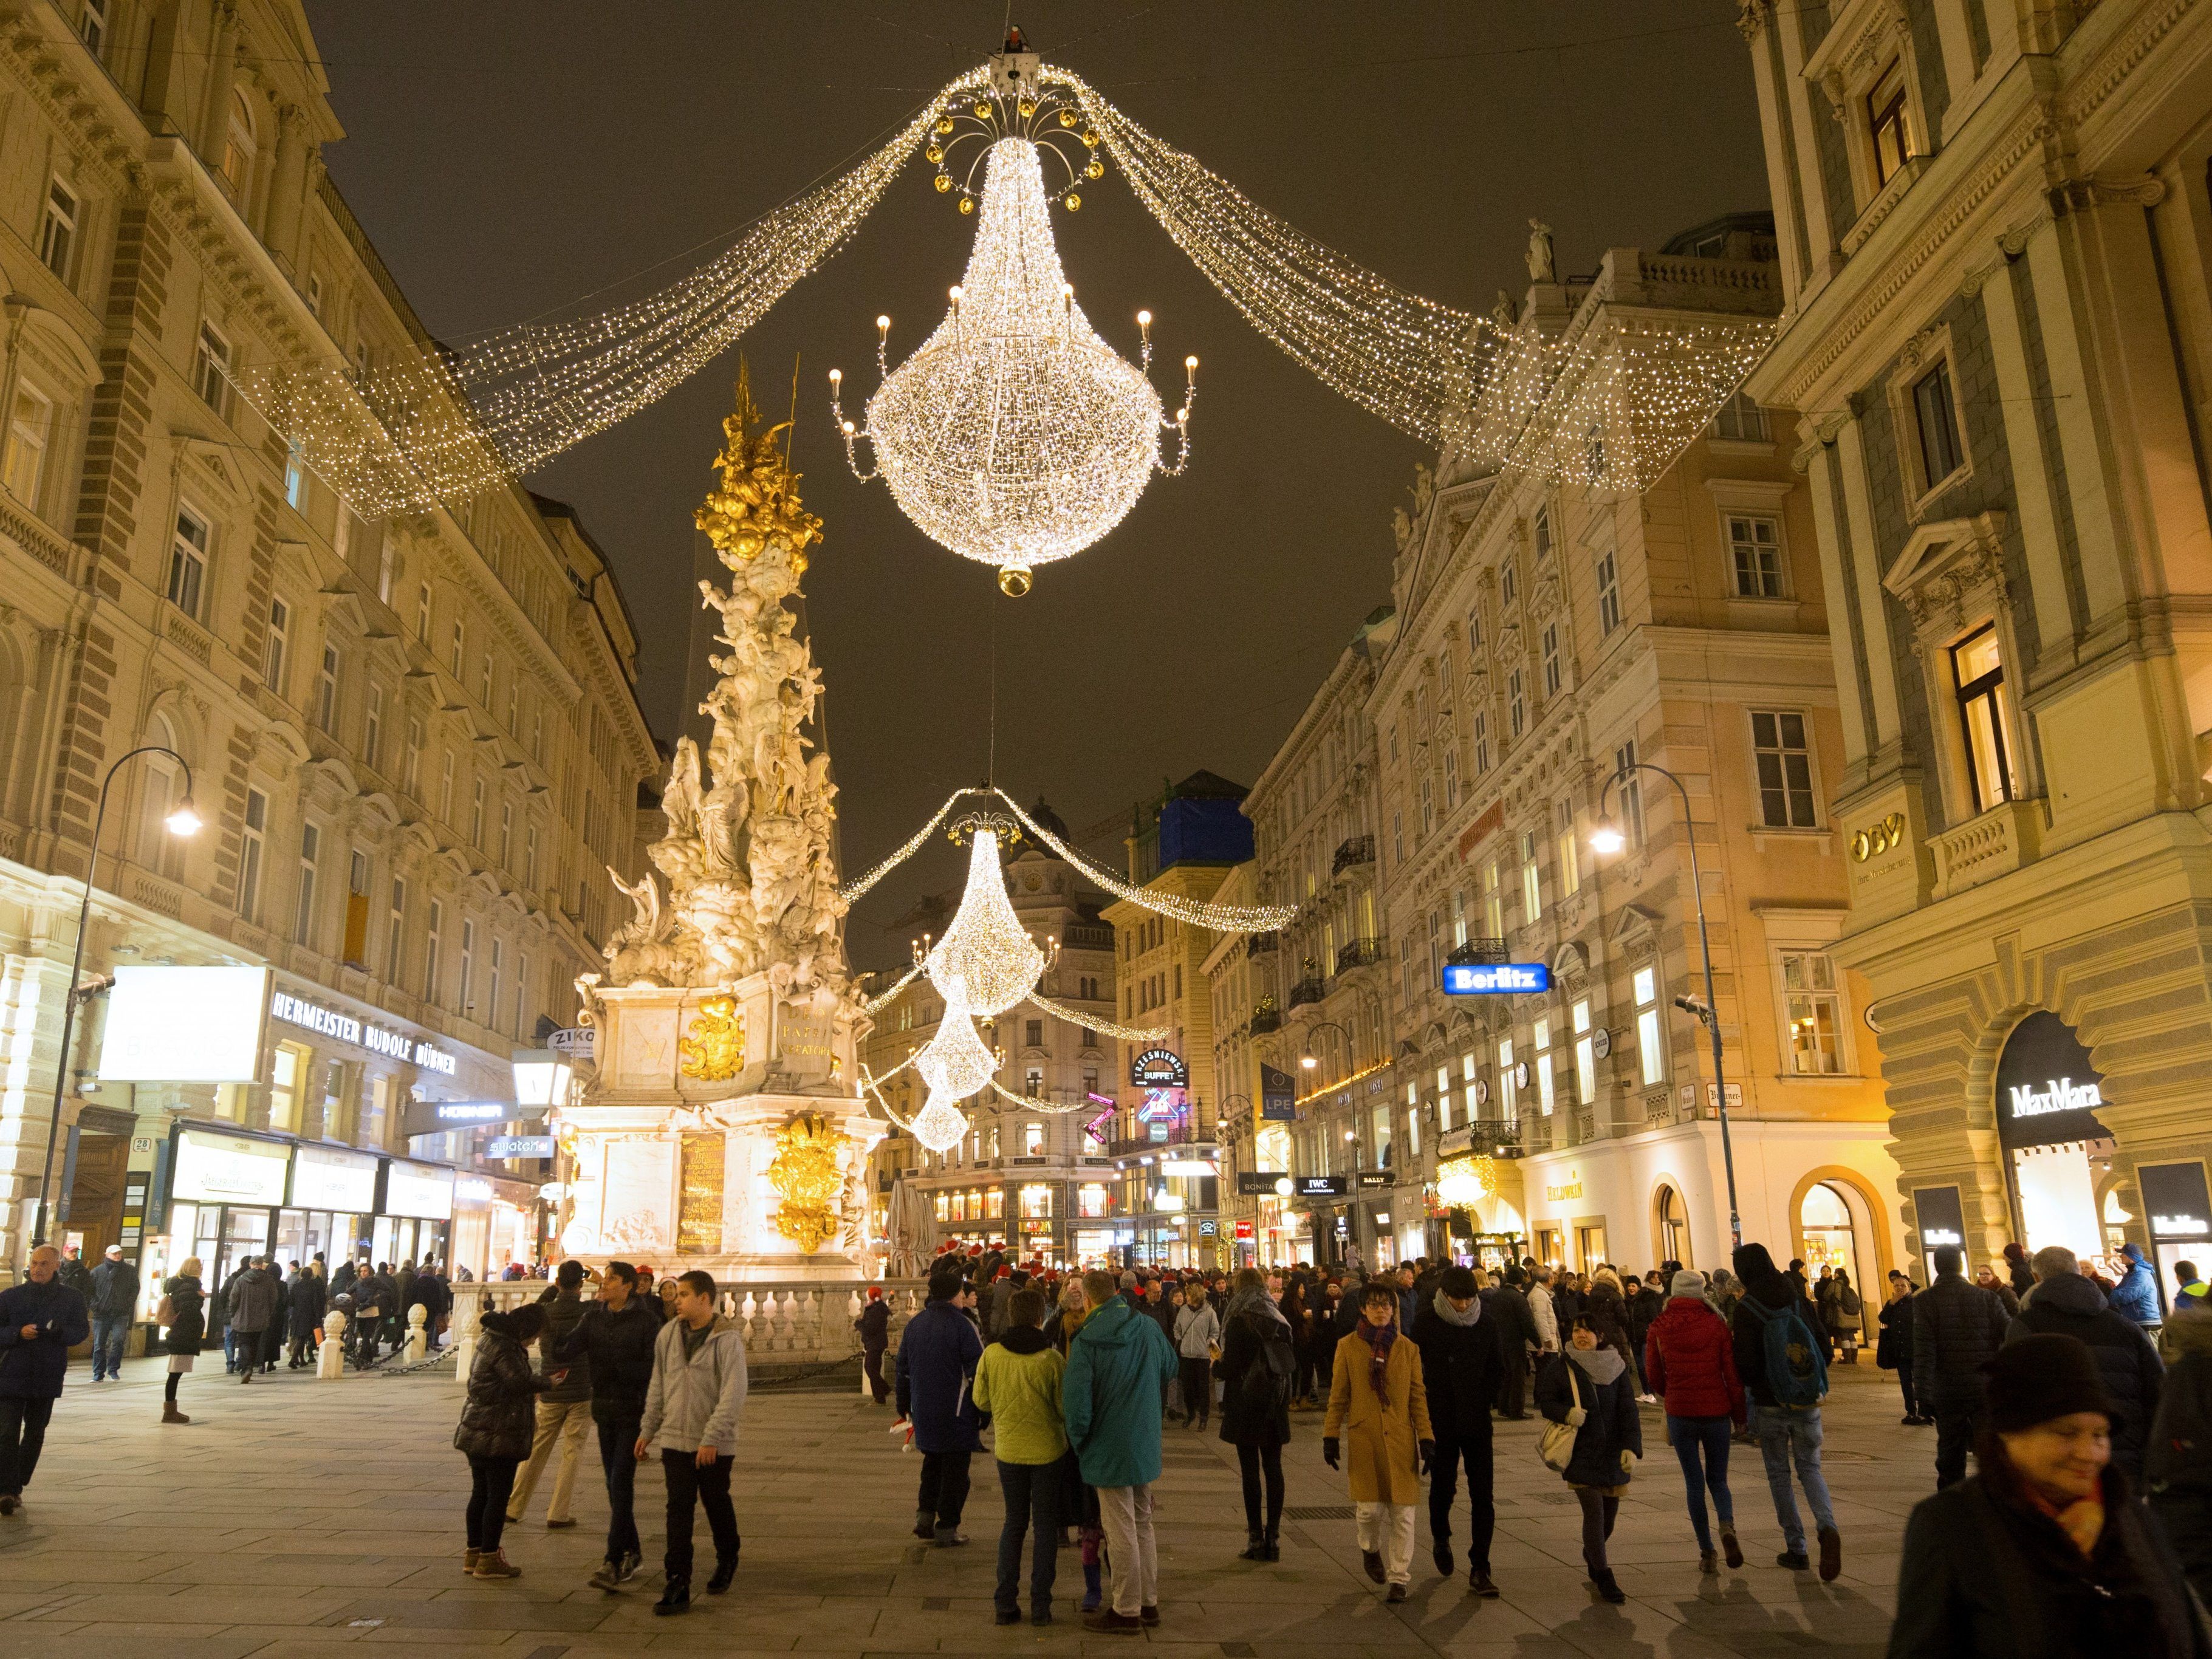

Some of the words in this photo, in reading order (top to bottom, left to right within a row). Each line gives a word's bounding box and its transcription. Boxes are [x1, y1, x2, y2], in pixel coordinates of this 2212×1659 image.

[1455, 967, 1536, 988] Berlitz
[788, 1005, 825, 1019] DEO
[365, 1025, 412, 1059] RUDOLF
[416, 1042, 456, 1075] HÜBNER
[1134, 1050, 1185, 1078] TRZEŚNIEWSKI
[1144, 1072, 1174, 1080] BUFFET
[1266, 1098, 1291, 1110] LPE
[2009, 1077, 2102, 1118] MaxMara
[489, 1140, 539, 1152] swatch
[1309, 1179, 1328, 1188] IWC
[1547, 1182, 1583, 1202] HELDWEIN
